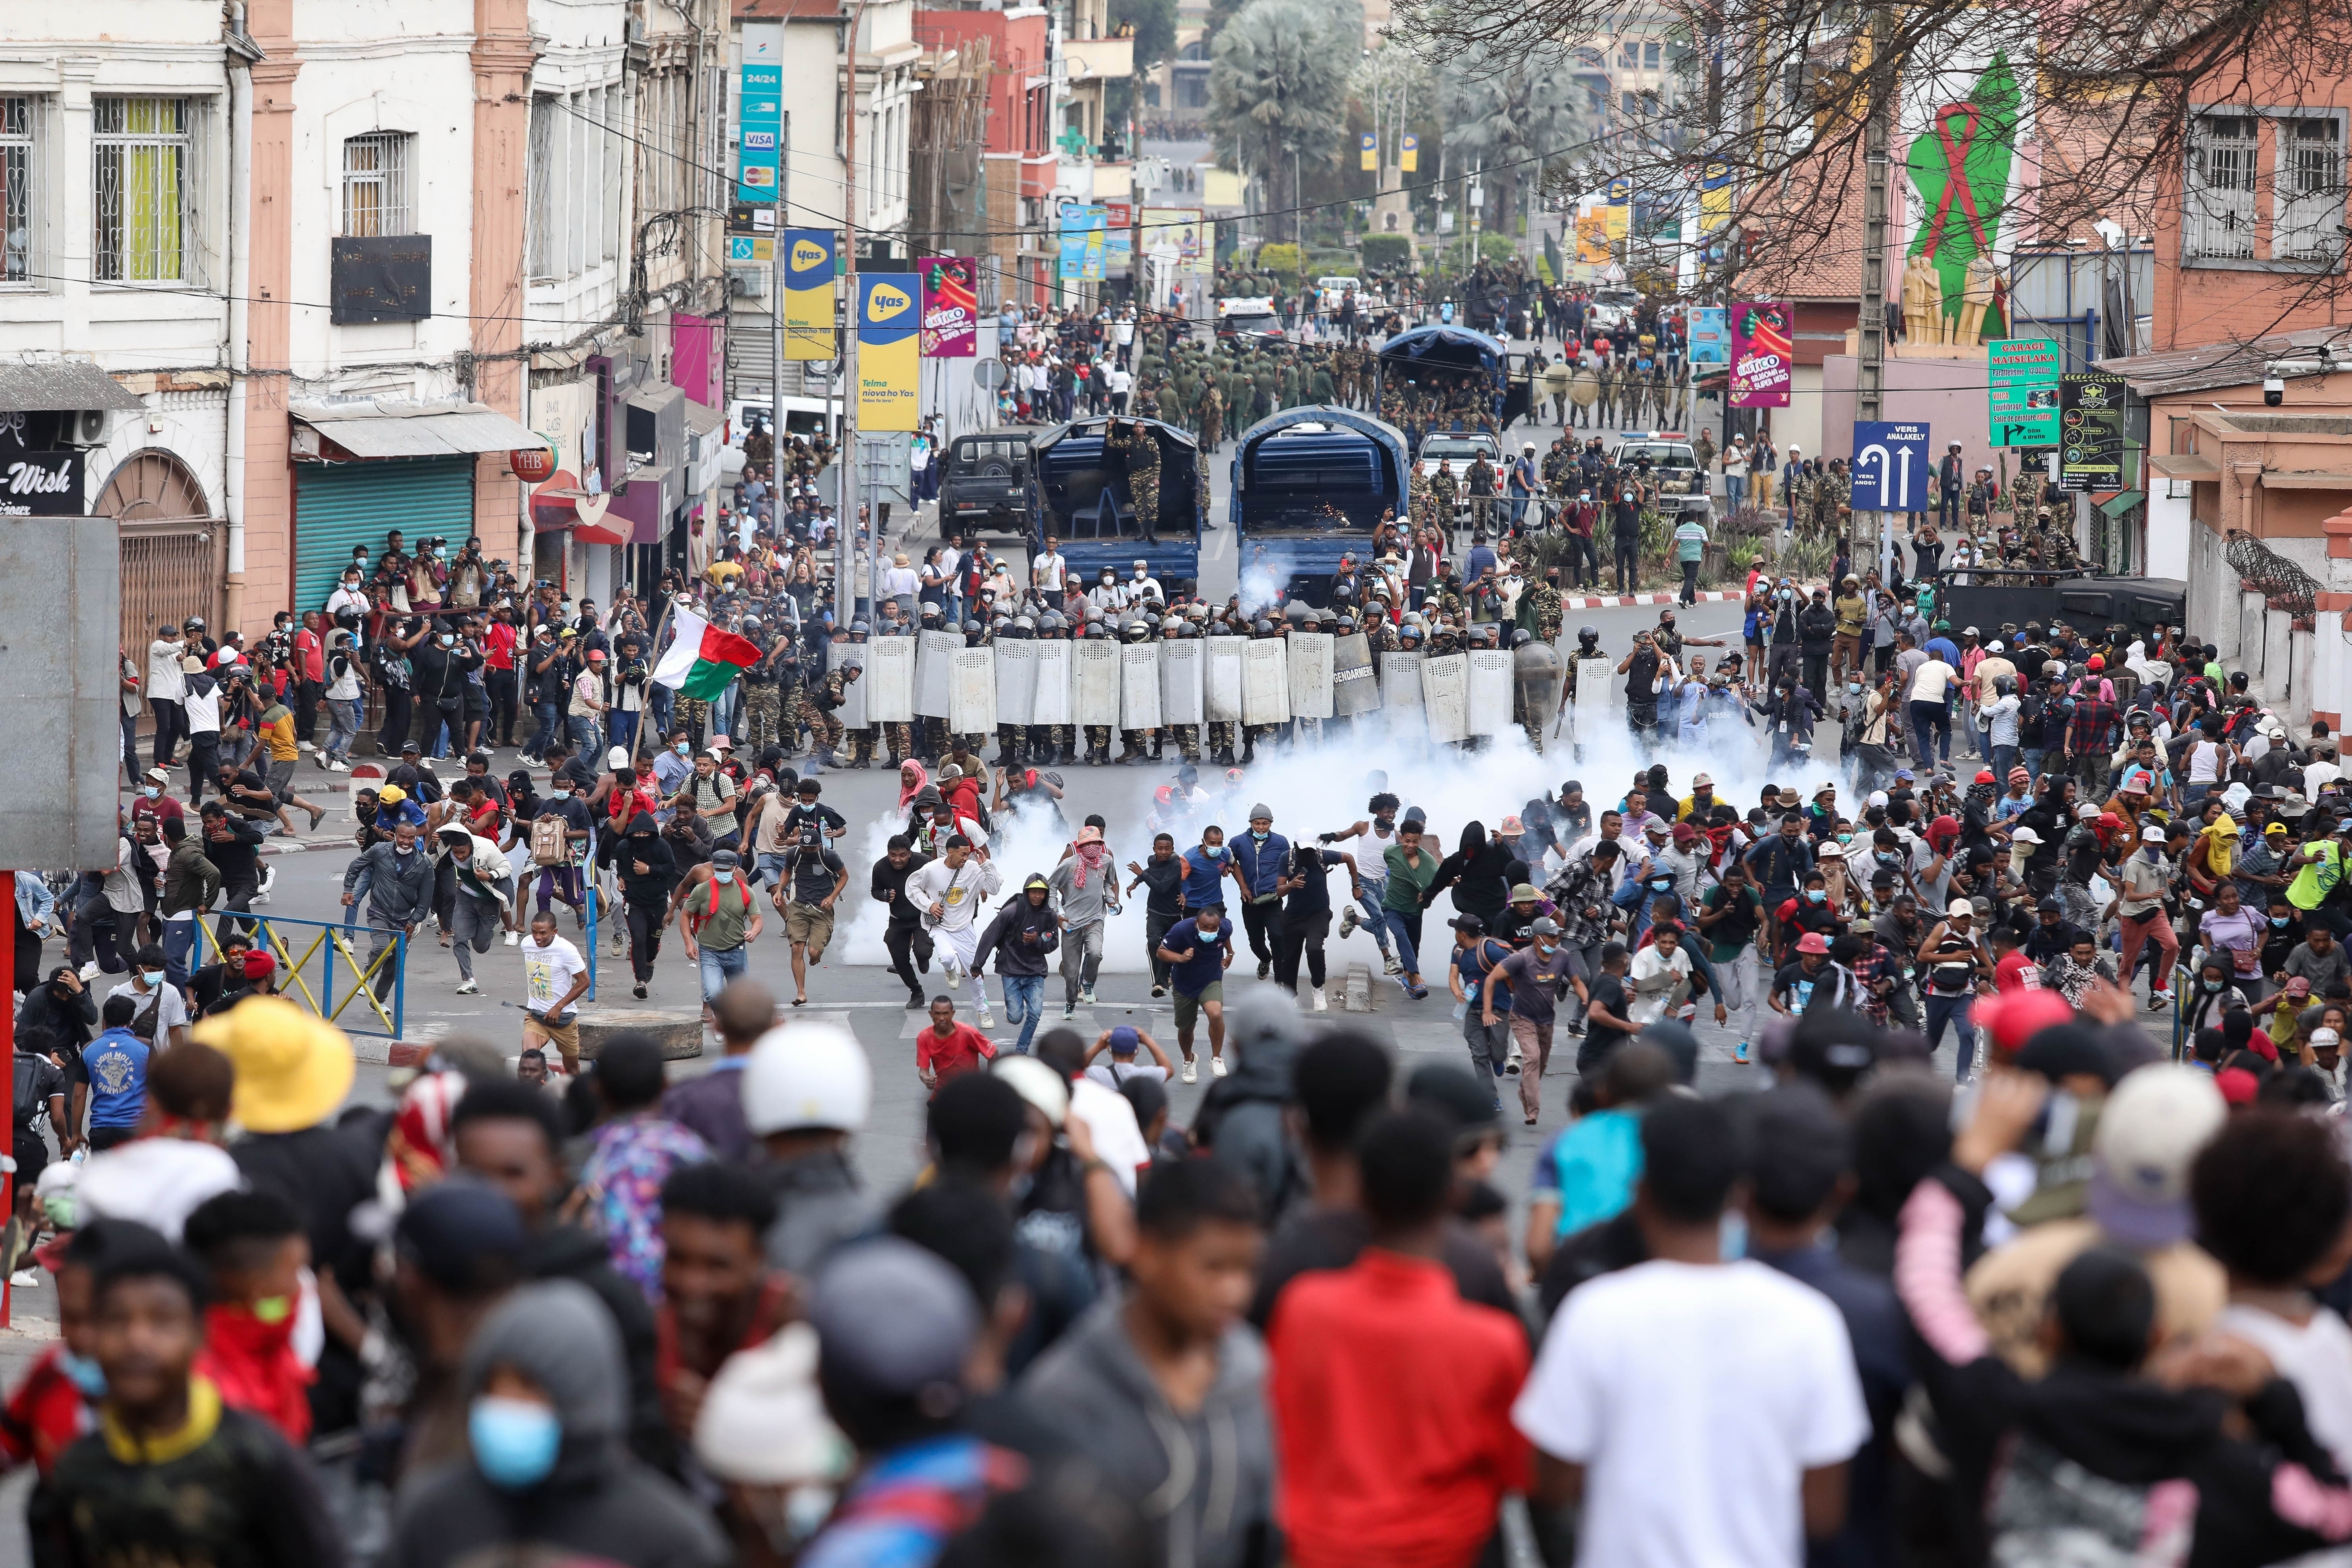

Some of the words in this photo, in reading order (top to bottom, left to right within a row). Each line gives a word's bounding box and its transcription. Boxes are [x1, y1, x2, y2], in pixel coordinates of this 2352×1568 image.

[747, 75, 776, 83] 24/24
[748, 135, 772, 145] VISA
[875, 296, 904, 313] yas
[2002, 342, 2045, 352] GARAGE
[1992, 354, 2056, 365] MATSELAKA
[1993, 392, 2009, 400] VULCA
[1993, 403, 2022, 412] Equilibrage
[2014, 414, 2036, 423] peinture
[516, 455, 542, 469] THB
[1334, 665, 1374, 683] GENDARMERIE
[95, 1052, 112, 1068] LIQUI
[114, 1052, 133, 1066] MOLY
[98, 1081, 132, 1094] GERMANY
